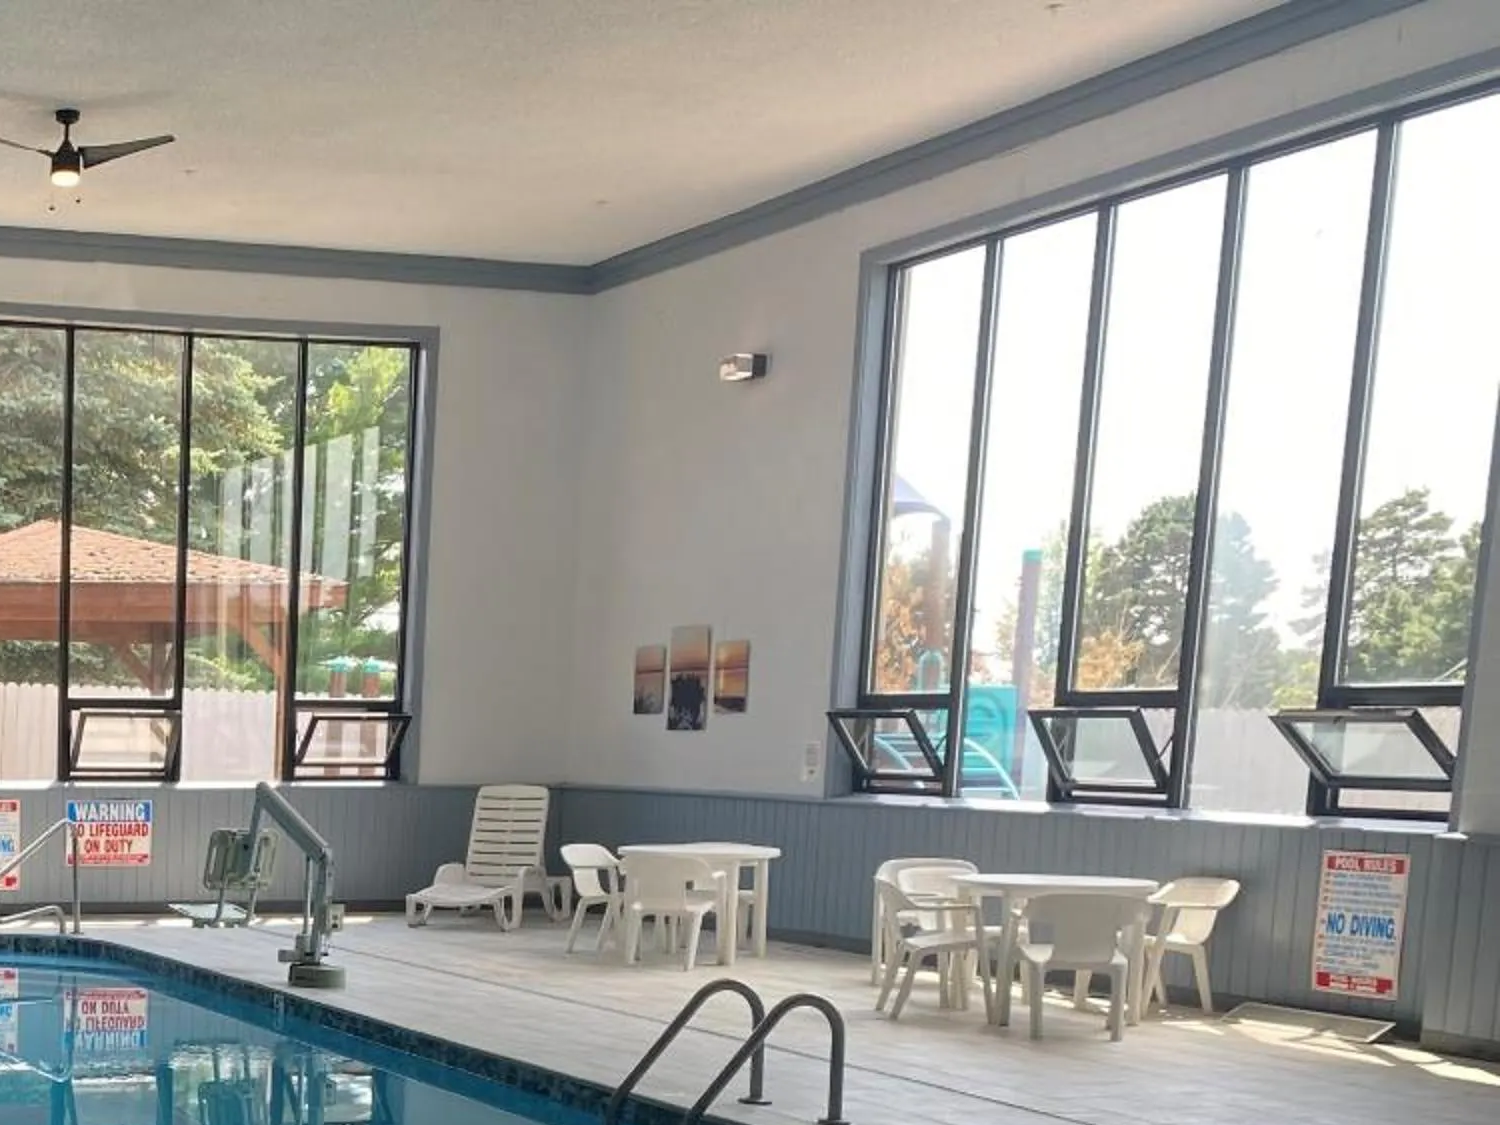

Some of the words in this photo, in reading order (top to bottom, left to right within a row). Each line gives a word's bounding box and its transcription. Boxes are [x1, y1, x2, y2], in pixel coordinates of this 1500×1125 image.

[76, 802, 145, 821] WARNING
[89, 823, 149, 837] LIFEGUARD
[83, 839, 100, 853] ON
[104, 839, 133, 853] DUTY
[1335, 855, 1360, 870] POOL
[1327, 912, 1345, 934] NO
